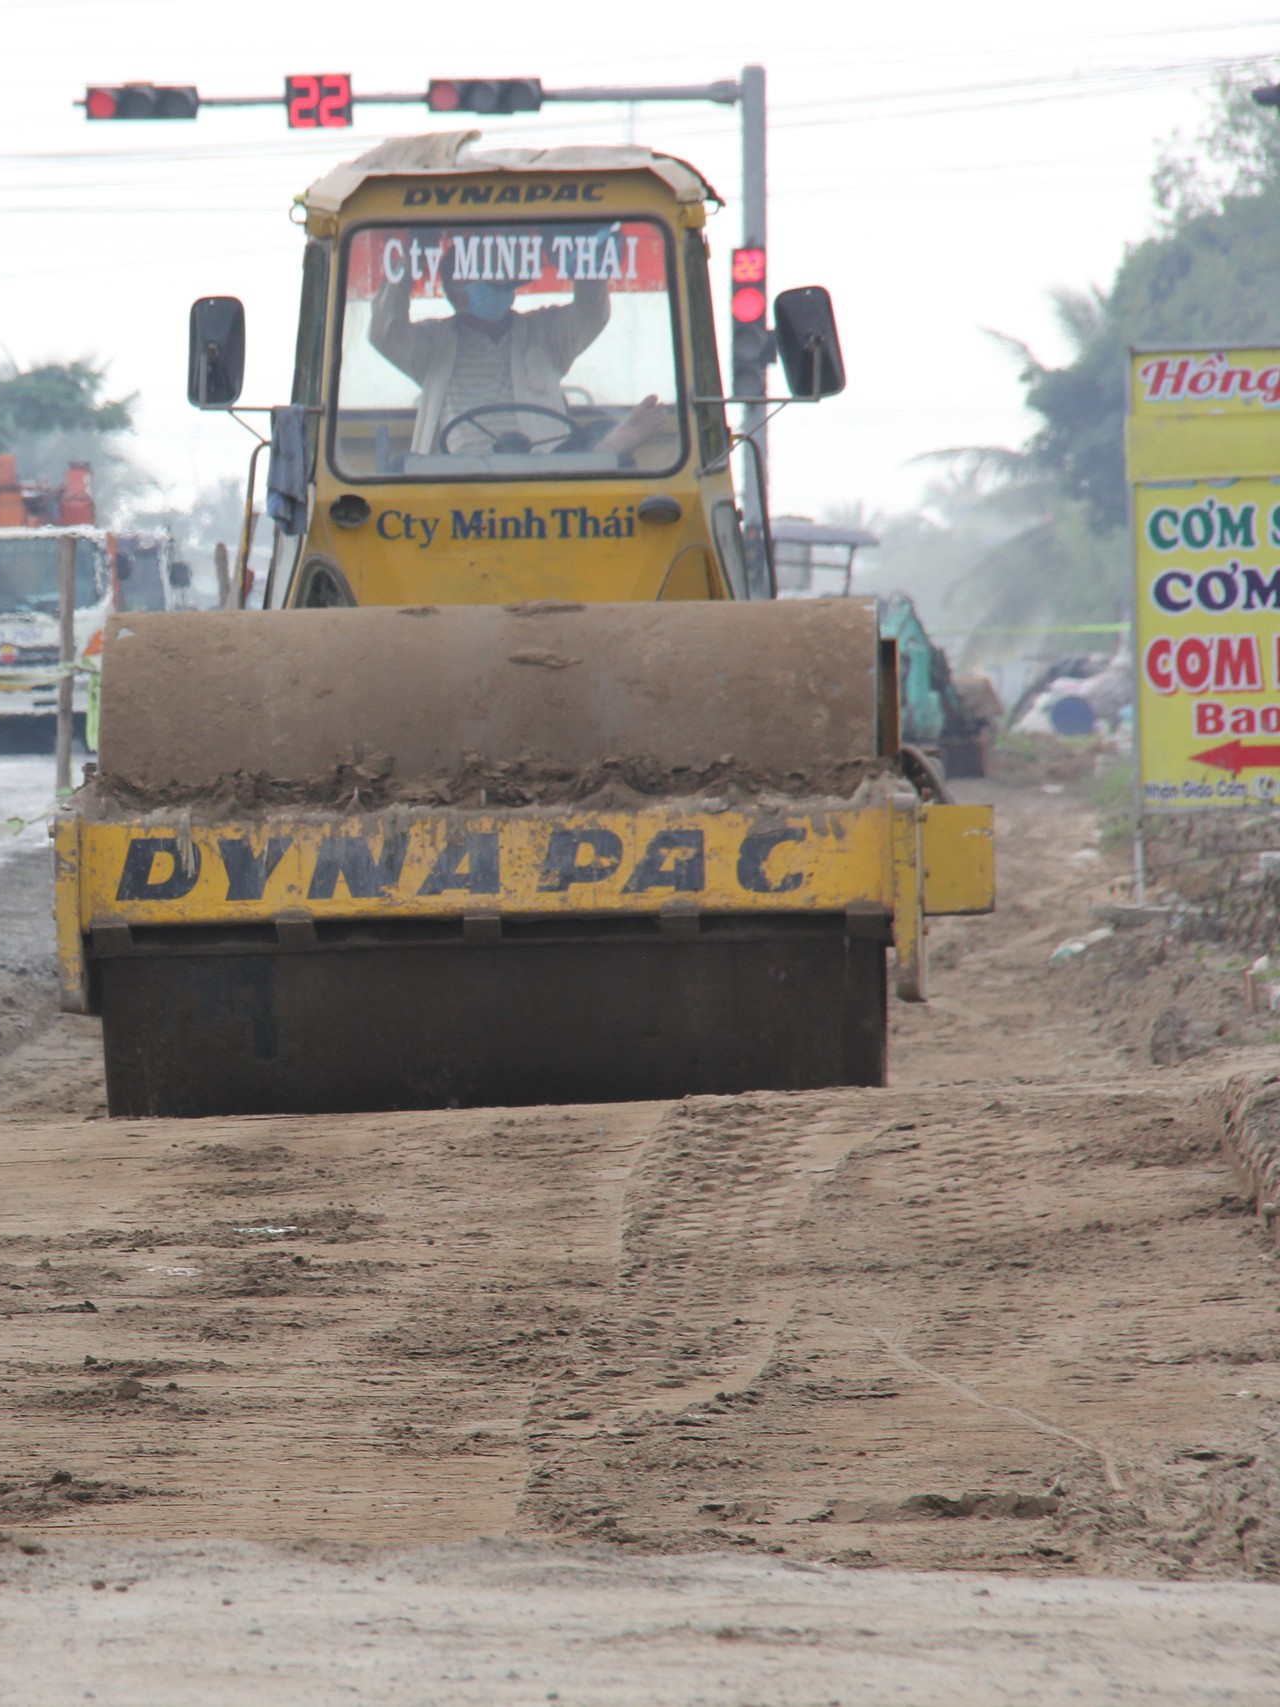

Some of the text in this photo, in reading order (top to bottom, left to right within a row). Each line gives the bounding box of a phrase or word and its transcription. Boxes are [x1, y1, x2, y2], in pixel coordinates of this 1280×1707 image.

[288, 75, 349, 128] 22
[403, 182, 605, 207] DYNAPAC
[383, 238, 443, 295] Cty
[452, 235, 543, 281] MINH
[376, 506, 636, 548] Cty Minh Thái
[1149, 499, 1255, 549] CƠM
[1153, 562, 1280, 611] CƠM
[1147, 637, 1258, 690] CƠM
[116, 827, 808, 902] DYNAPAC
